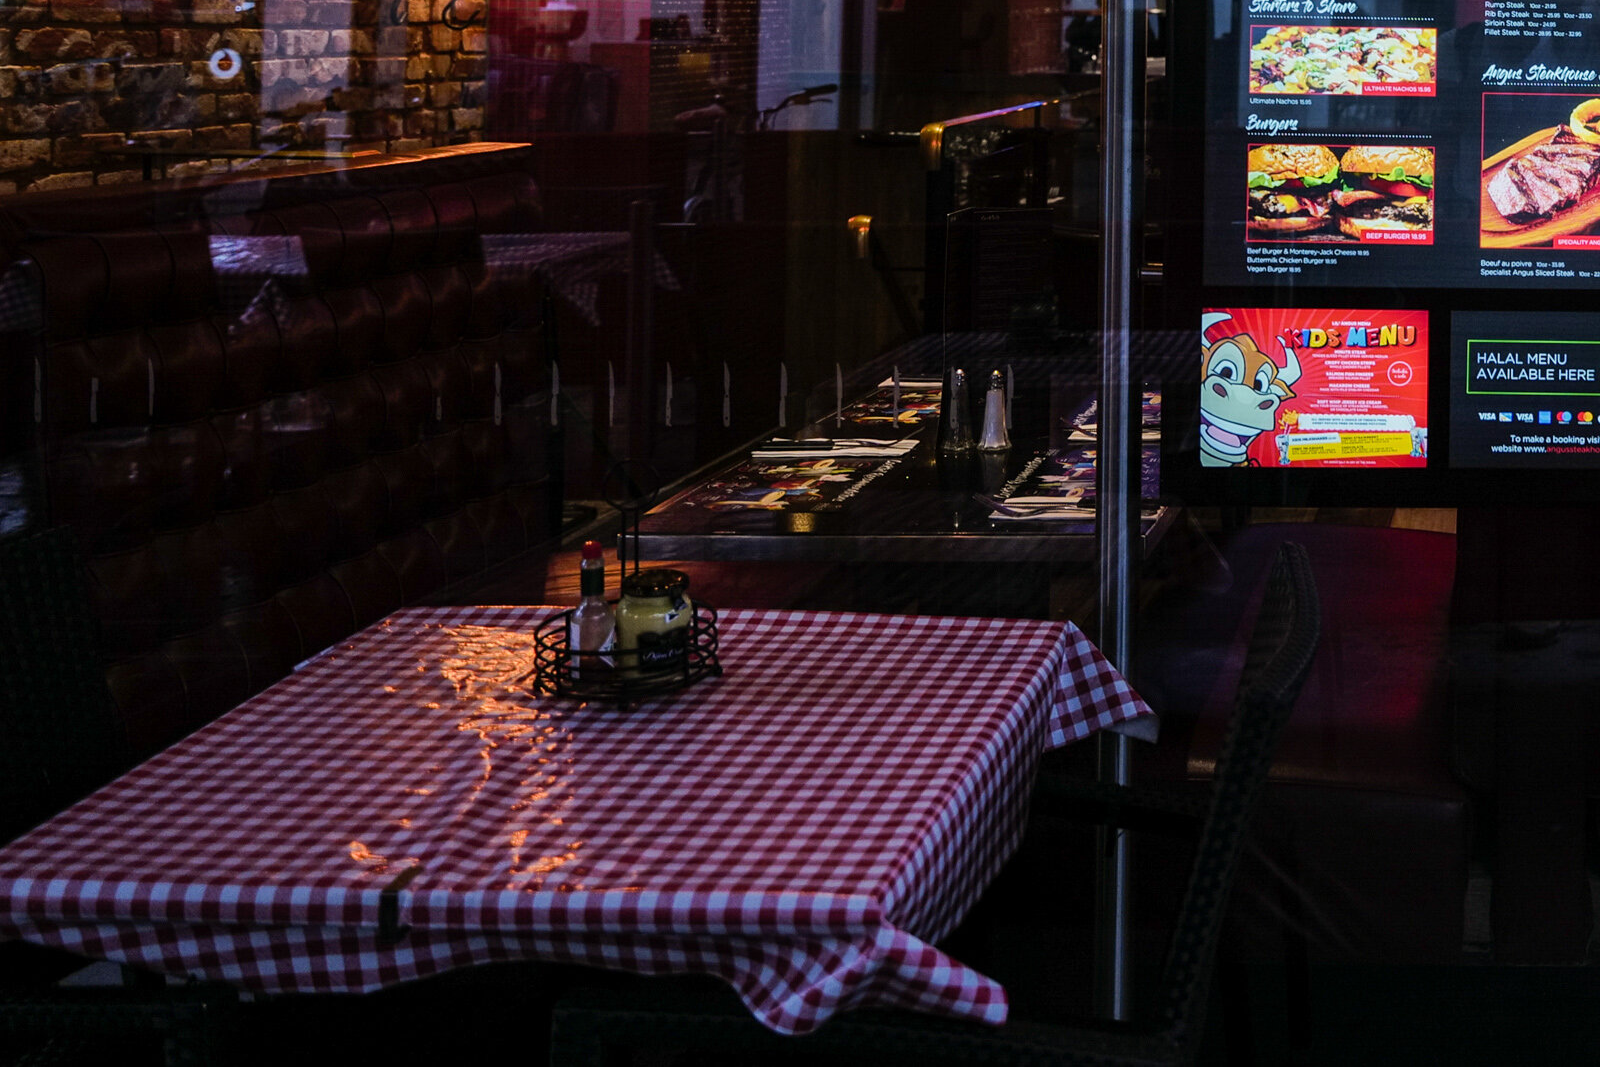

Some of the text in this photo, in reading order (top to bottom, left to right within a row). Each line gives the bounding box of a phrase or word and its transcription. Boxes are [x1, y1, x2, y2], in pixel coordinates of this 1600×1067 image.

[1485, 1, 1505, 9] Rump
[1498, 11, 1511, 19] Eye
[1481, 65, 1522, 85] Angus
[1526, 64, 1597, 82] Steakhouse
[1245, 114, 1298, 136] Burgers
[1511, 260, 1532, 268] poivre
[1284, 324, 1416, 348] KIDS MENU
[1477, 352, 1567, 365] HALAL MENU
[1476, 368, 1595, 381] AVAILABLE HERE
[1478, 412, 1496, 420] VISA
[1516, 413, 1534, 422] VISA
[1552, 435, 1585, 445] booking
[1491, 445, 1522, 453] website
